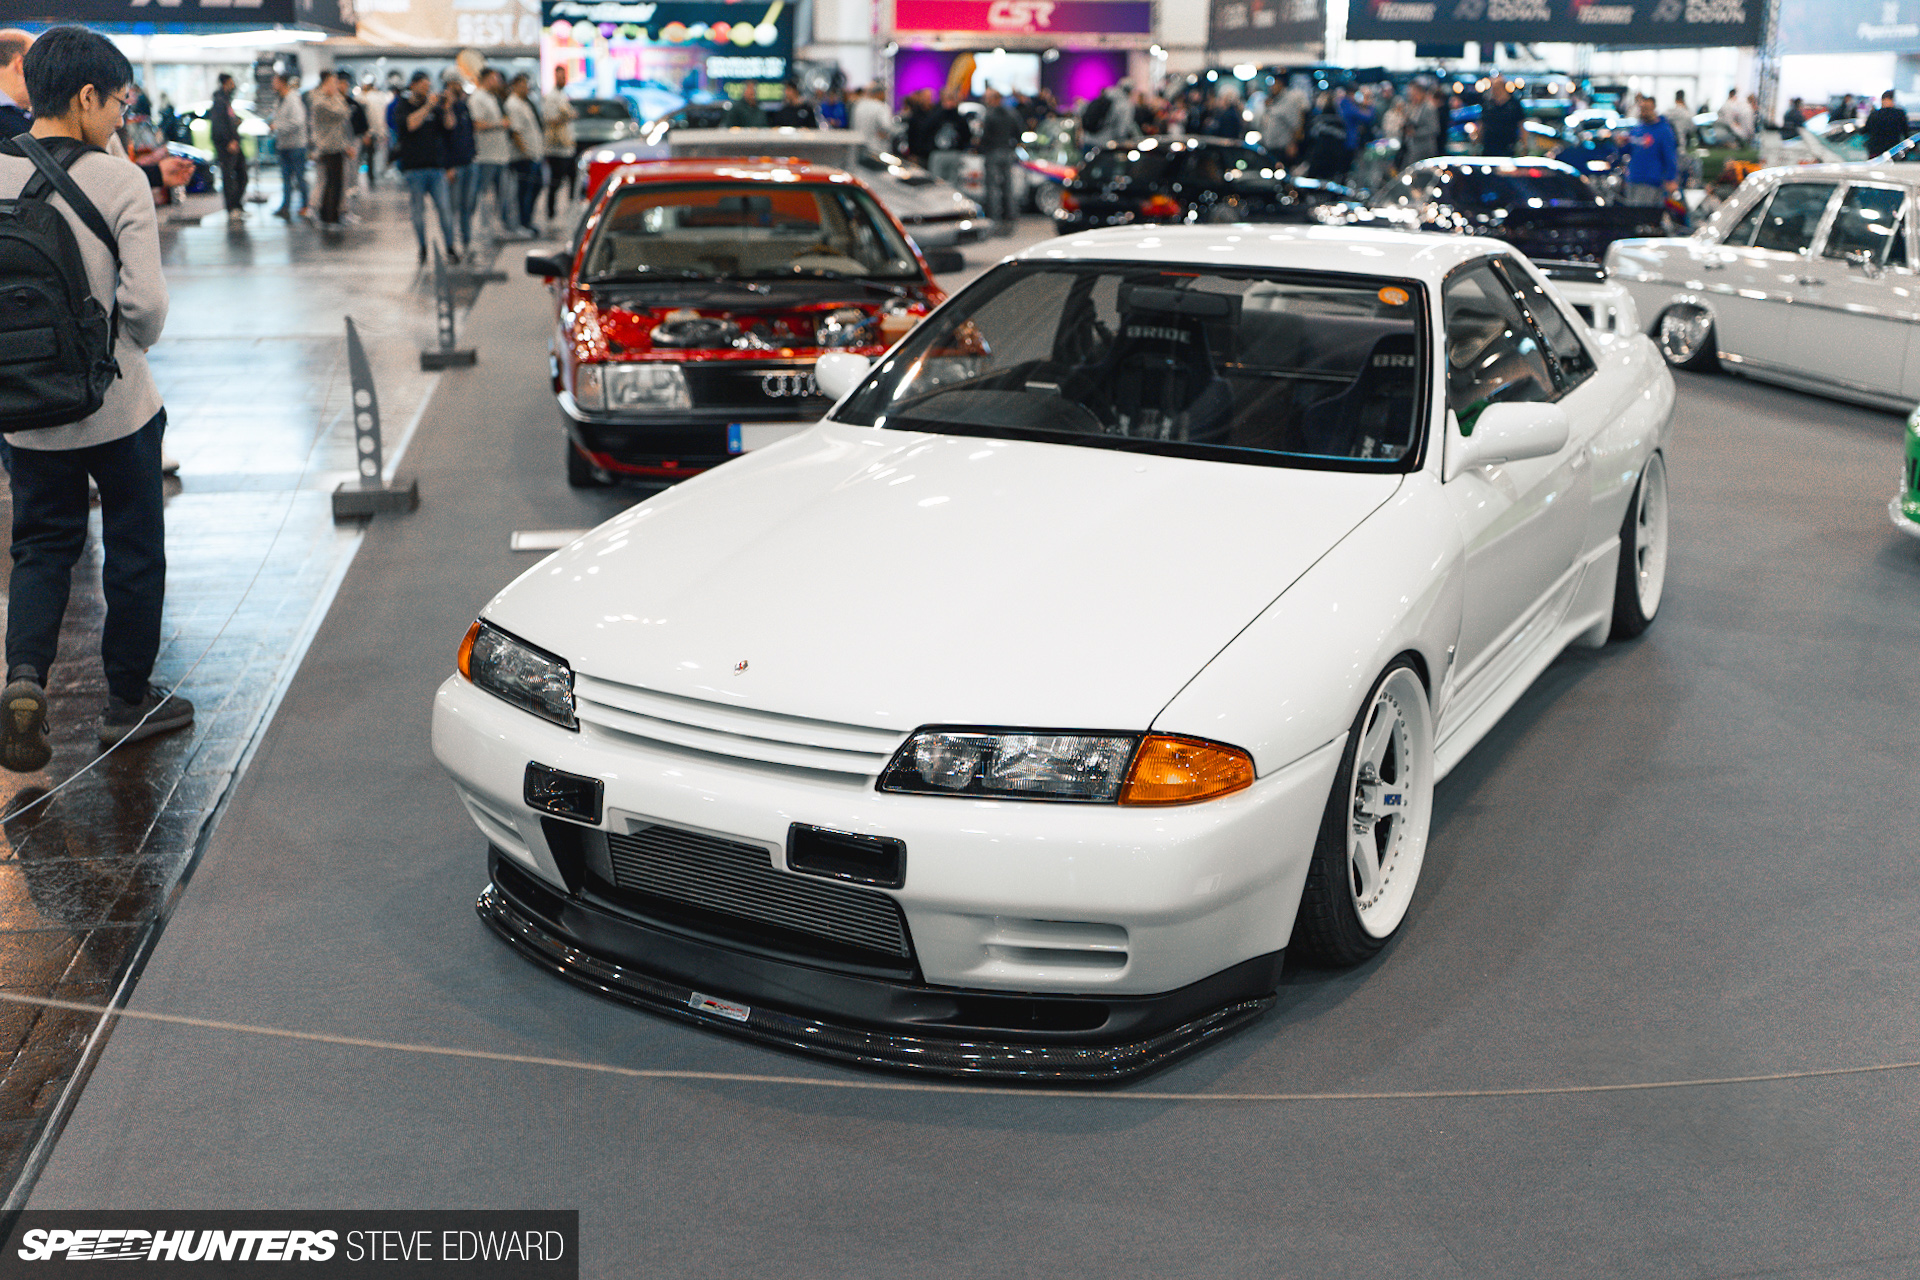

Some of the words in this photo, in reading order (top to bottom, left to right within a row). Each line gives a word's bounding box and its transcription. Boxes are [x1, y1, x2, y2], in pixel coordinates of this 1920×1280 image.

[457, 13, 514, 45] BEST
[1126, 324, 1191, 344] BRIDE
[1372, 354, 1415, 367] BRI
